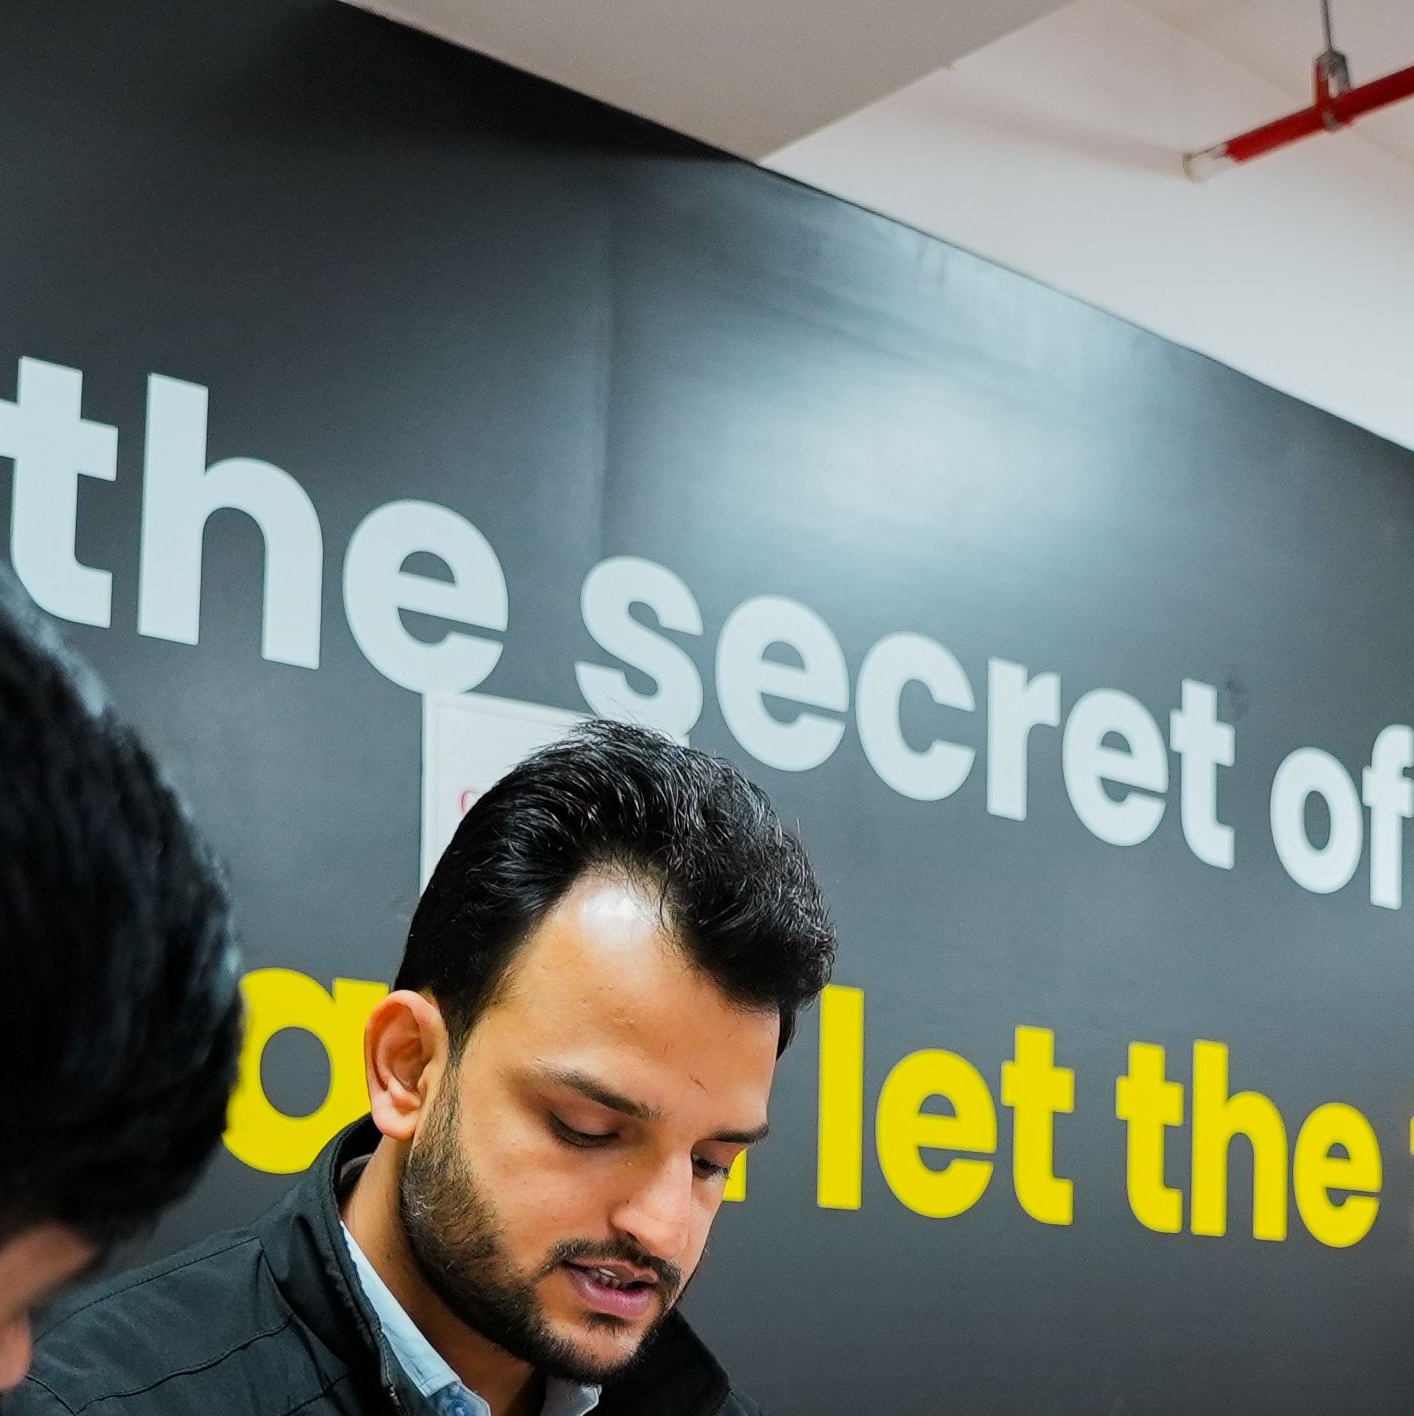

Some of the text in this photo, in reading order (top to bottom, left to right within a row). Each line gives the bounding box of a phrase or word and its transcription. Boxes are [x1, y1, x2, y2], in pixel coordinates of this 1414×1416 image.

[575, 555, 1236, 870] secret
[817, 985, 1074, 1226] let
[1115, 1038, 1384, 1249] the
